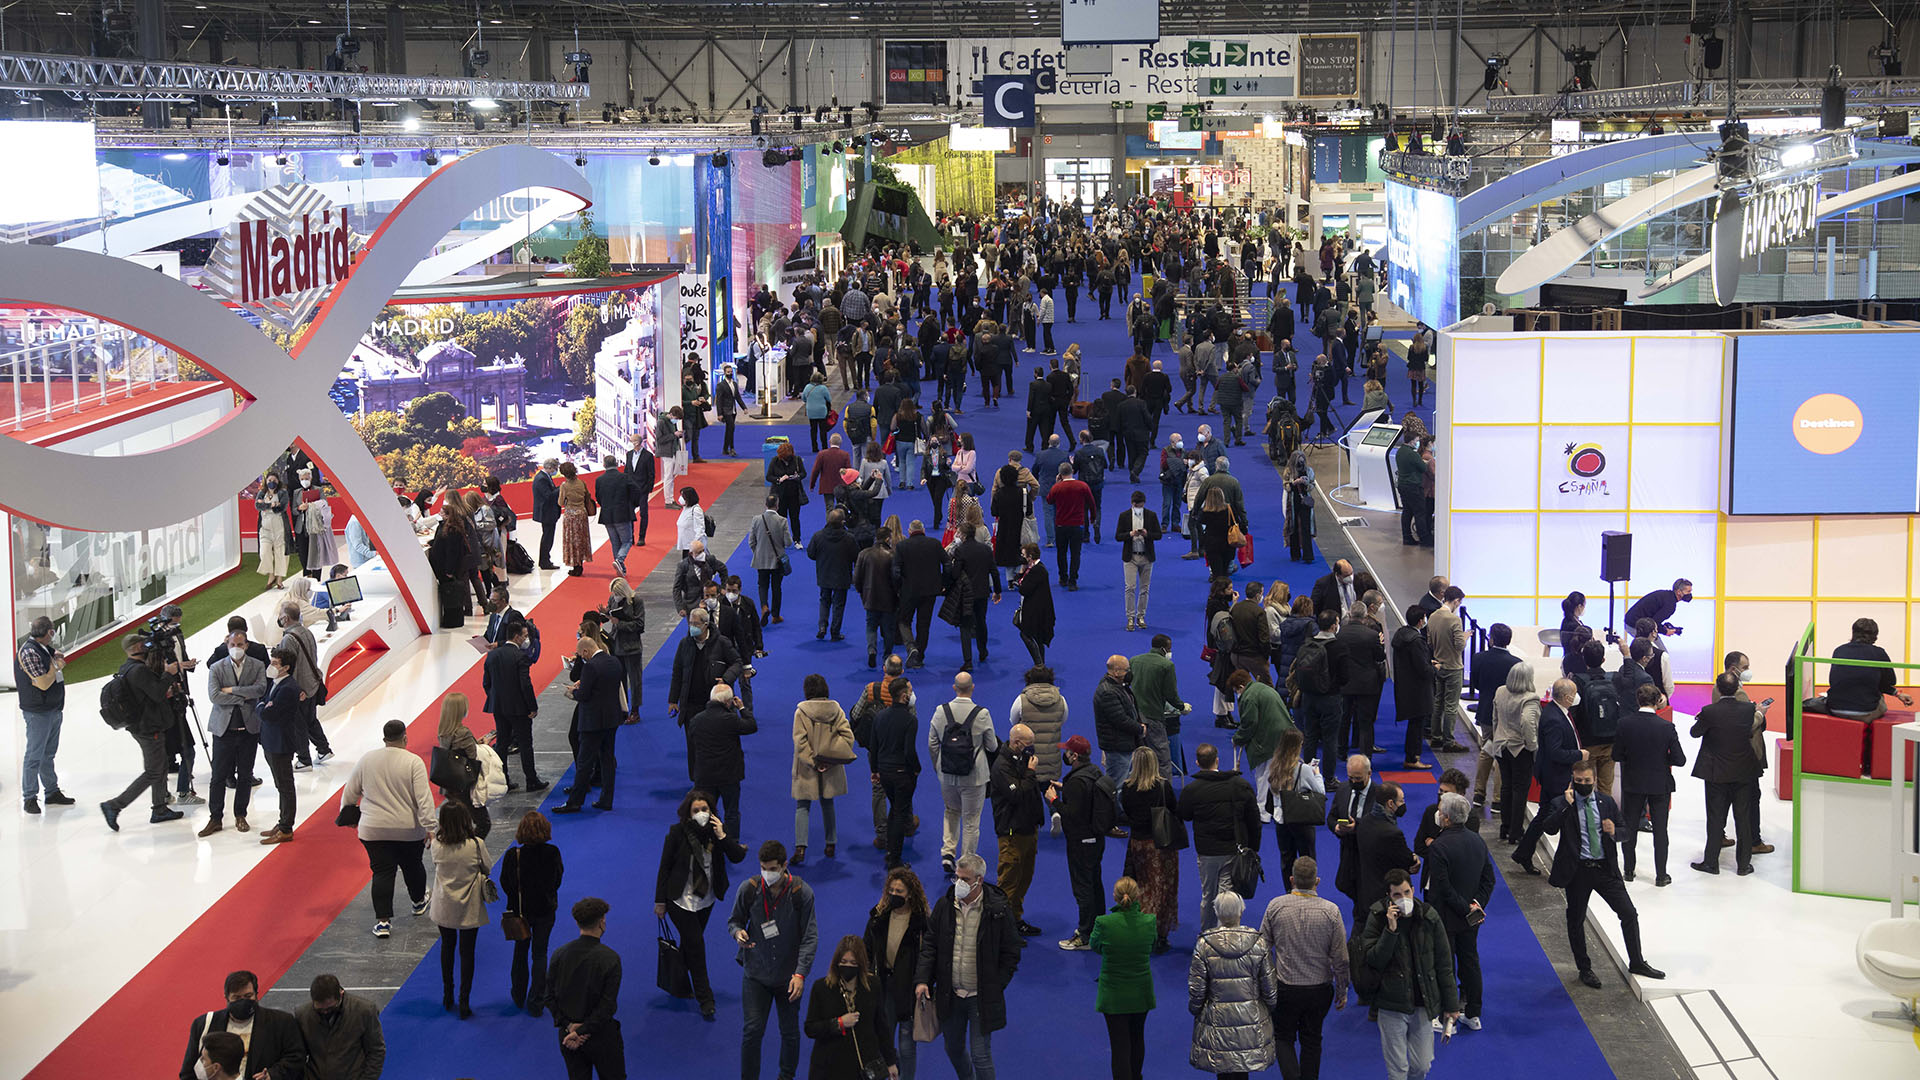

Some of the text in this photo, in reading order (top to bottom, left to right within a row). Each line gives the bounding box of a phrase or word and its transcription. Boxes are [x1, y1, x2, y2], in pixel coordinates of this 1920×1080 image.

[999, 48, 1066, 70] Cafet
[1139, 47, 1291, 68] Restunte
[1306, 56, 1355, 65] NON STOP
[890, 71, 906, 80] QUI
[1036, 71, 1051, 90] C
[994, 81, 1024, 120] C
[1173, 165, 1251, 187] La Rioja
[240, 207, 349, 303] Madrid
[372, 319, 454, 337] MADRID
[1558, 478, 1610, 496] ESPAÑA
